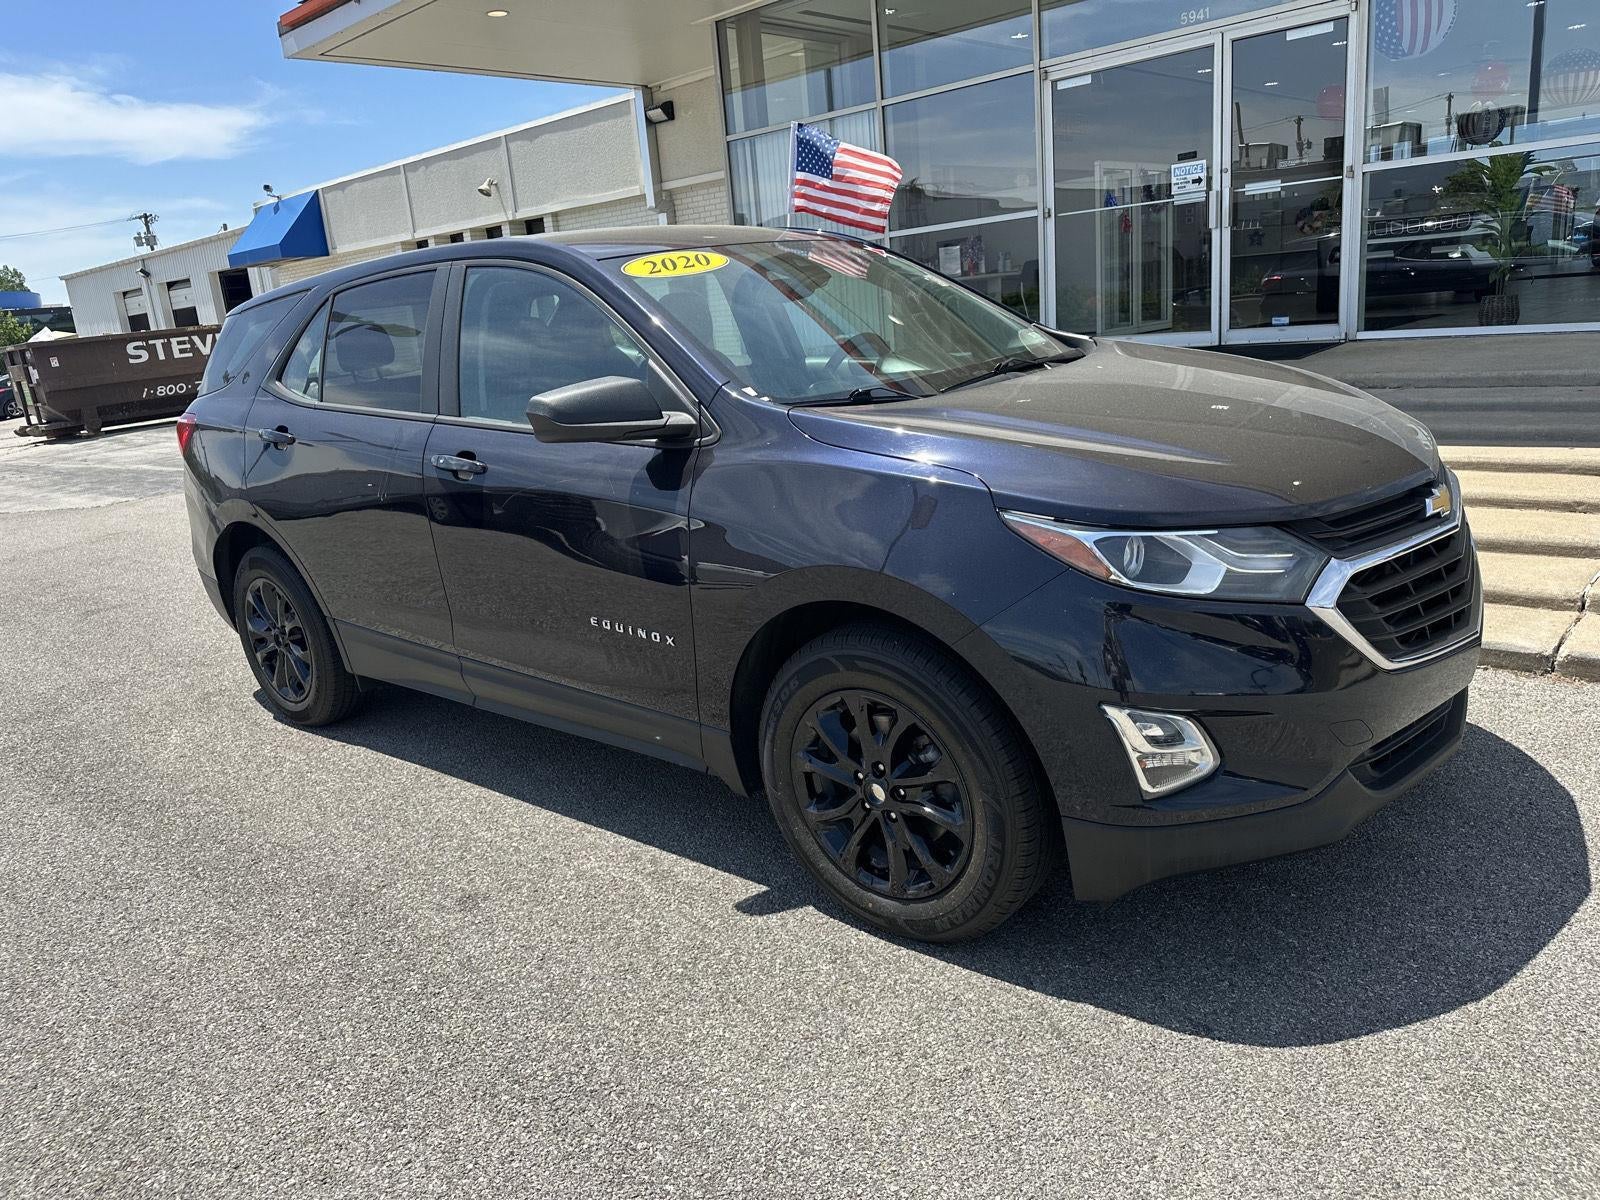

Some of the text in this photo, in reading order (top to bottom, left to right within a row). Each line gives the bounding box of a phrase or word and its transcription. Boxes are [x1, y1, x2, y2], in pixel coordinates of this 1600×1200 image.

[1180, 7, 1210, 25] 5941
[1174, 164, 1203, 177] NOTICE
[643, 253, 711, 275] 2020
[126, 333, 221, 364] STEV
[590, 616, 675, 647] EQUINOX
